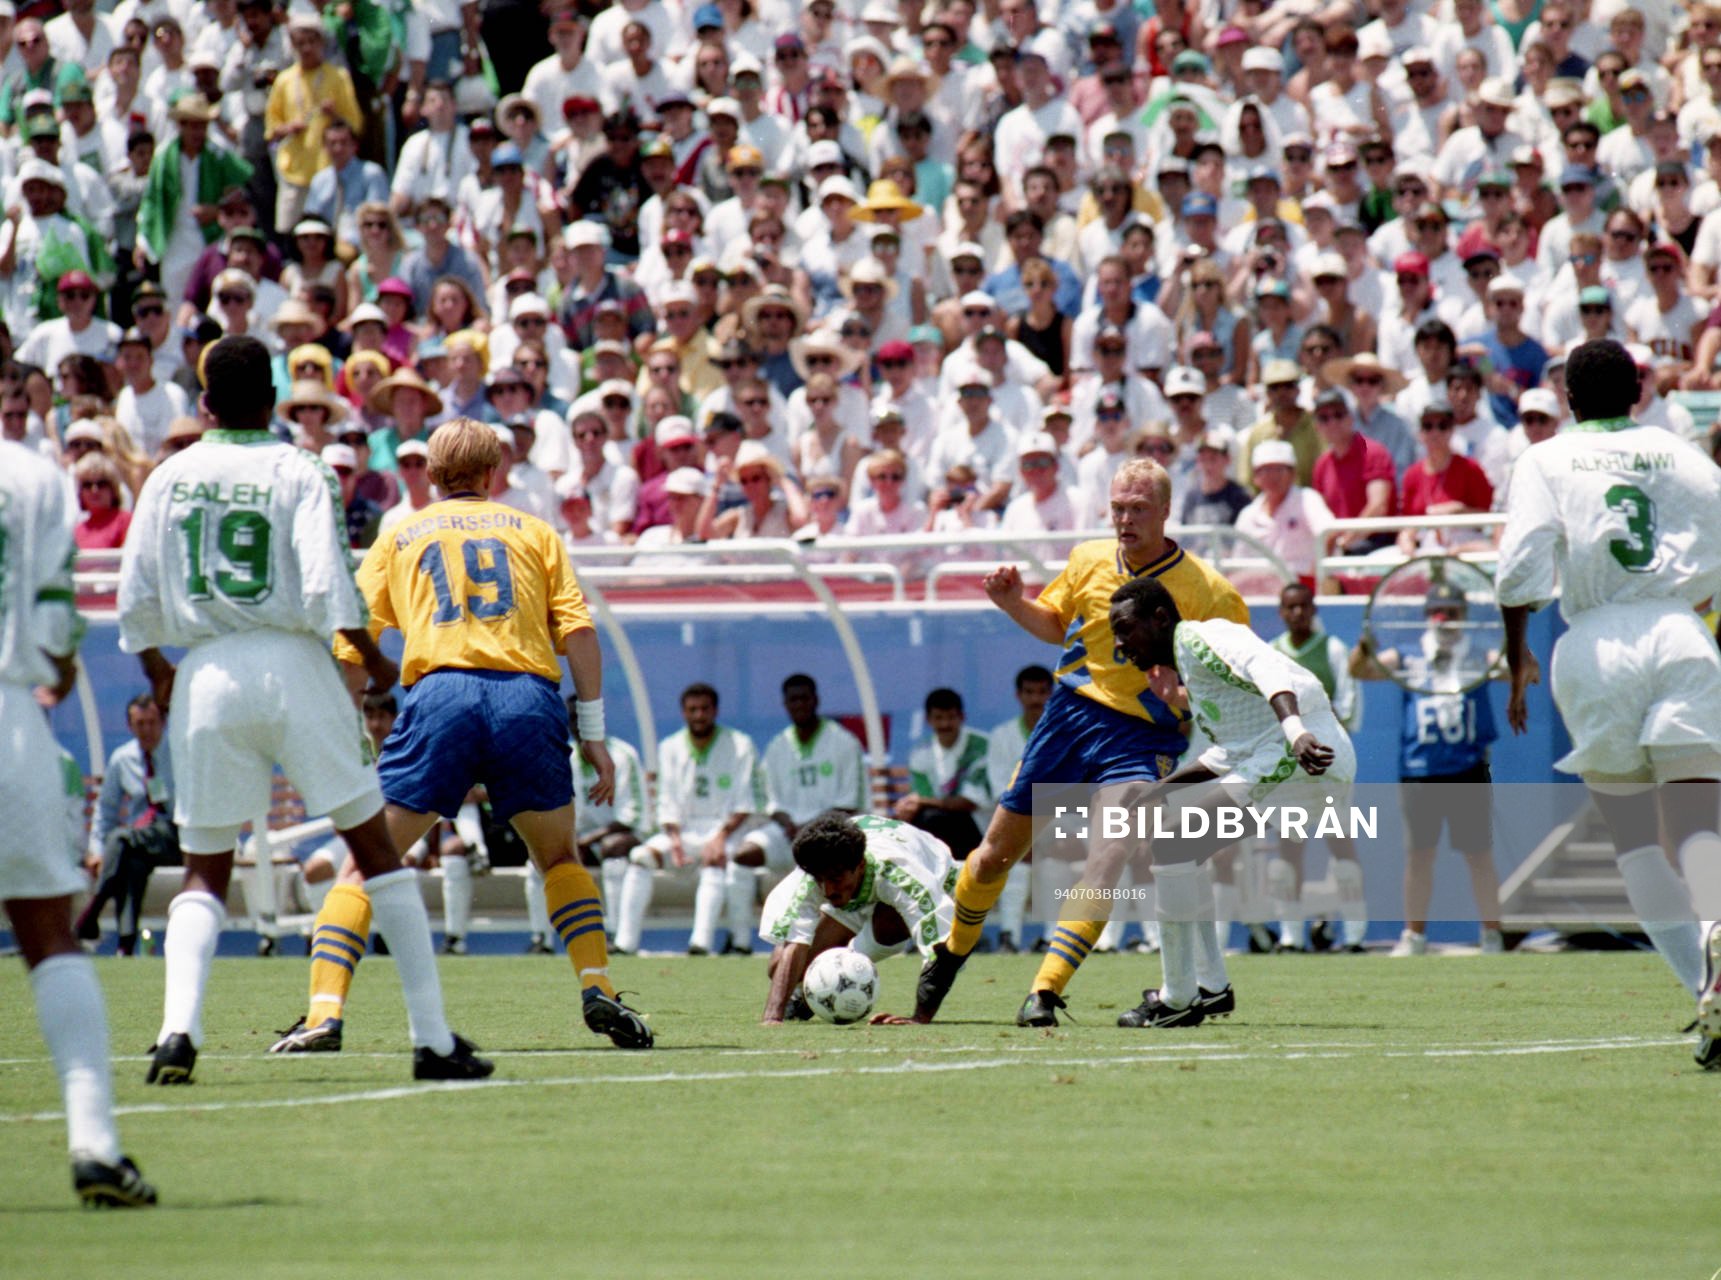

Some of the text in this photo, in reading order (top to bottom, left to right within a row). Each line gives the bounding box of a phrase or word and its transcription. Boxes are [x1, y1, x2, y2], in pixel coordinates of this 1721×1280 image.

[172, 481, 272, 505] SALEH
[395, 512, 523, 551] ANDERSSON
[1604, 484, 1662, 573] 3
[180, 506, 272, 605] 19
[419, 537, 519, 628] 19
